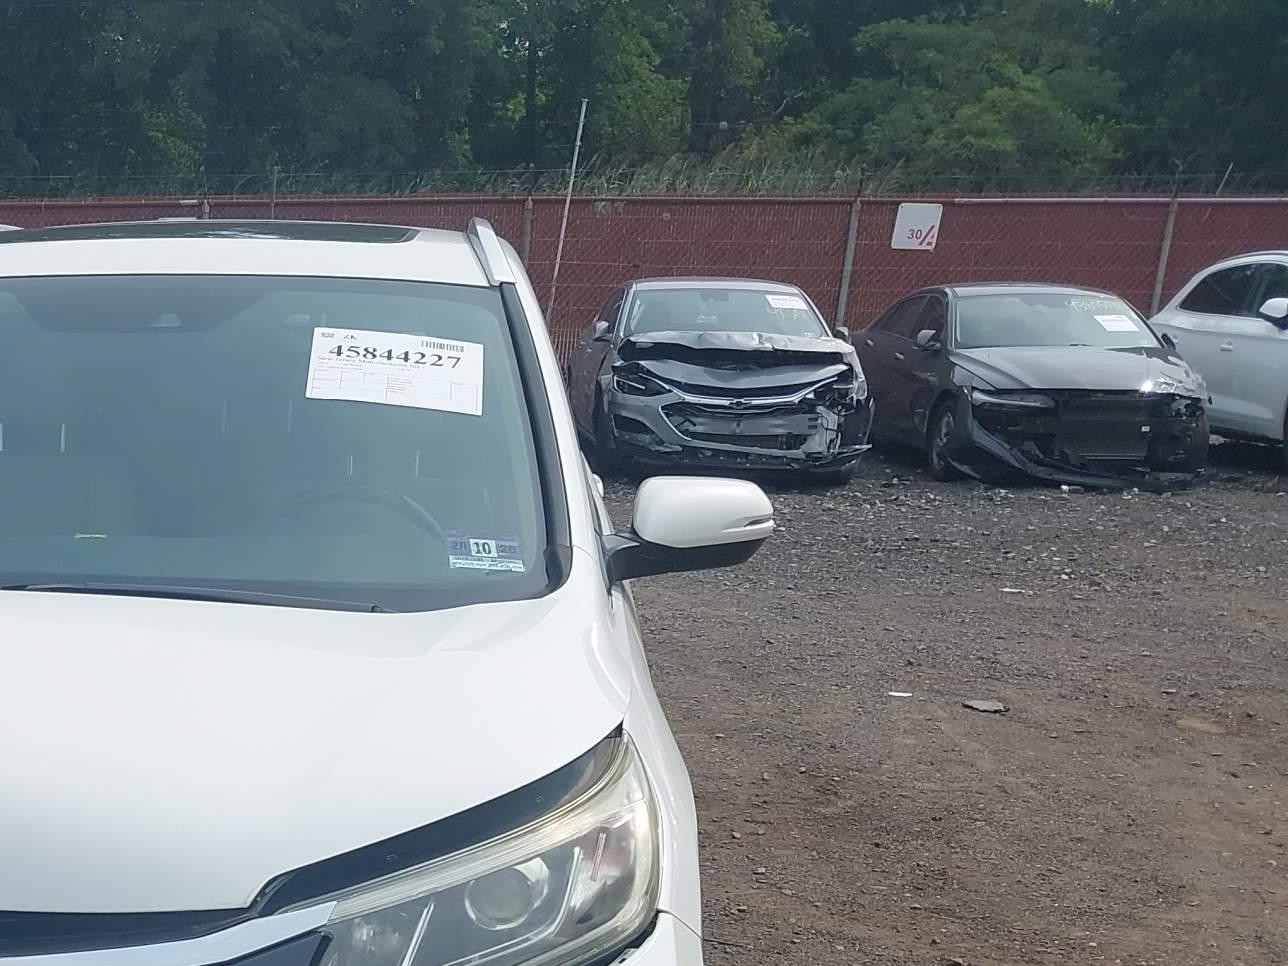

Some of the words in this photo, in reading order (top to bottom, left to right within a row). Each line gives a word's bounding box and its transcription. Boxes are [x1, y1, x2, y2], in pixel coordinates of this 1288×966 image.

[907, 228, 923, 240] 30
[328, 344, 462, 369] 45844227
[473, 542, 492, 555] 10
